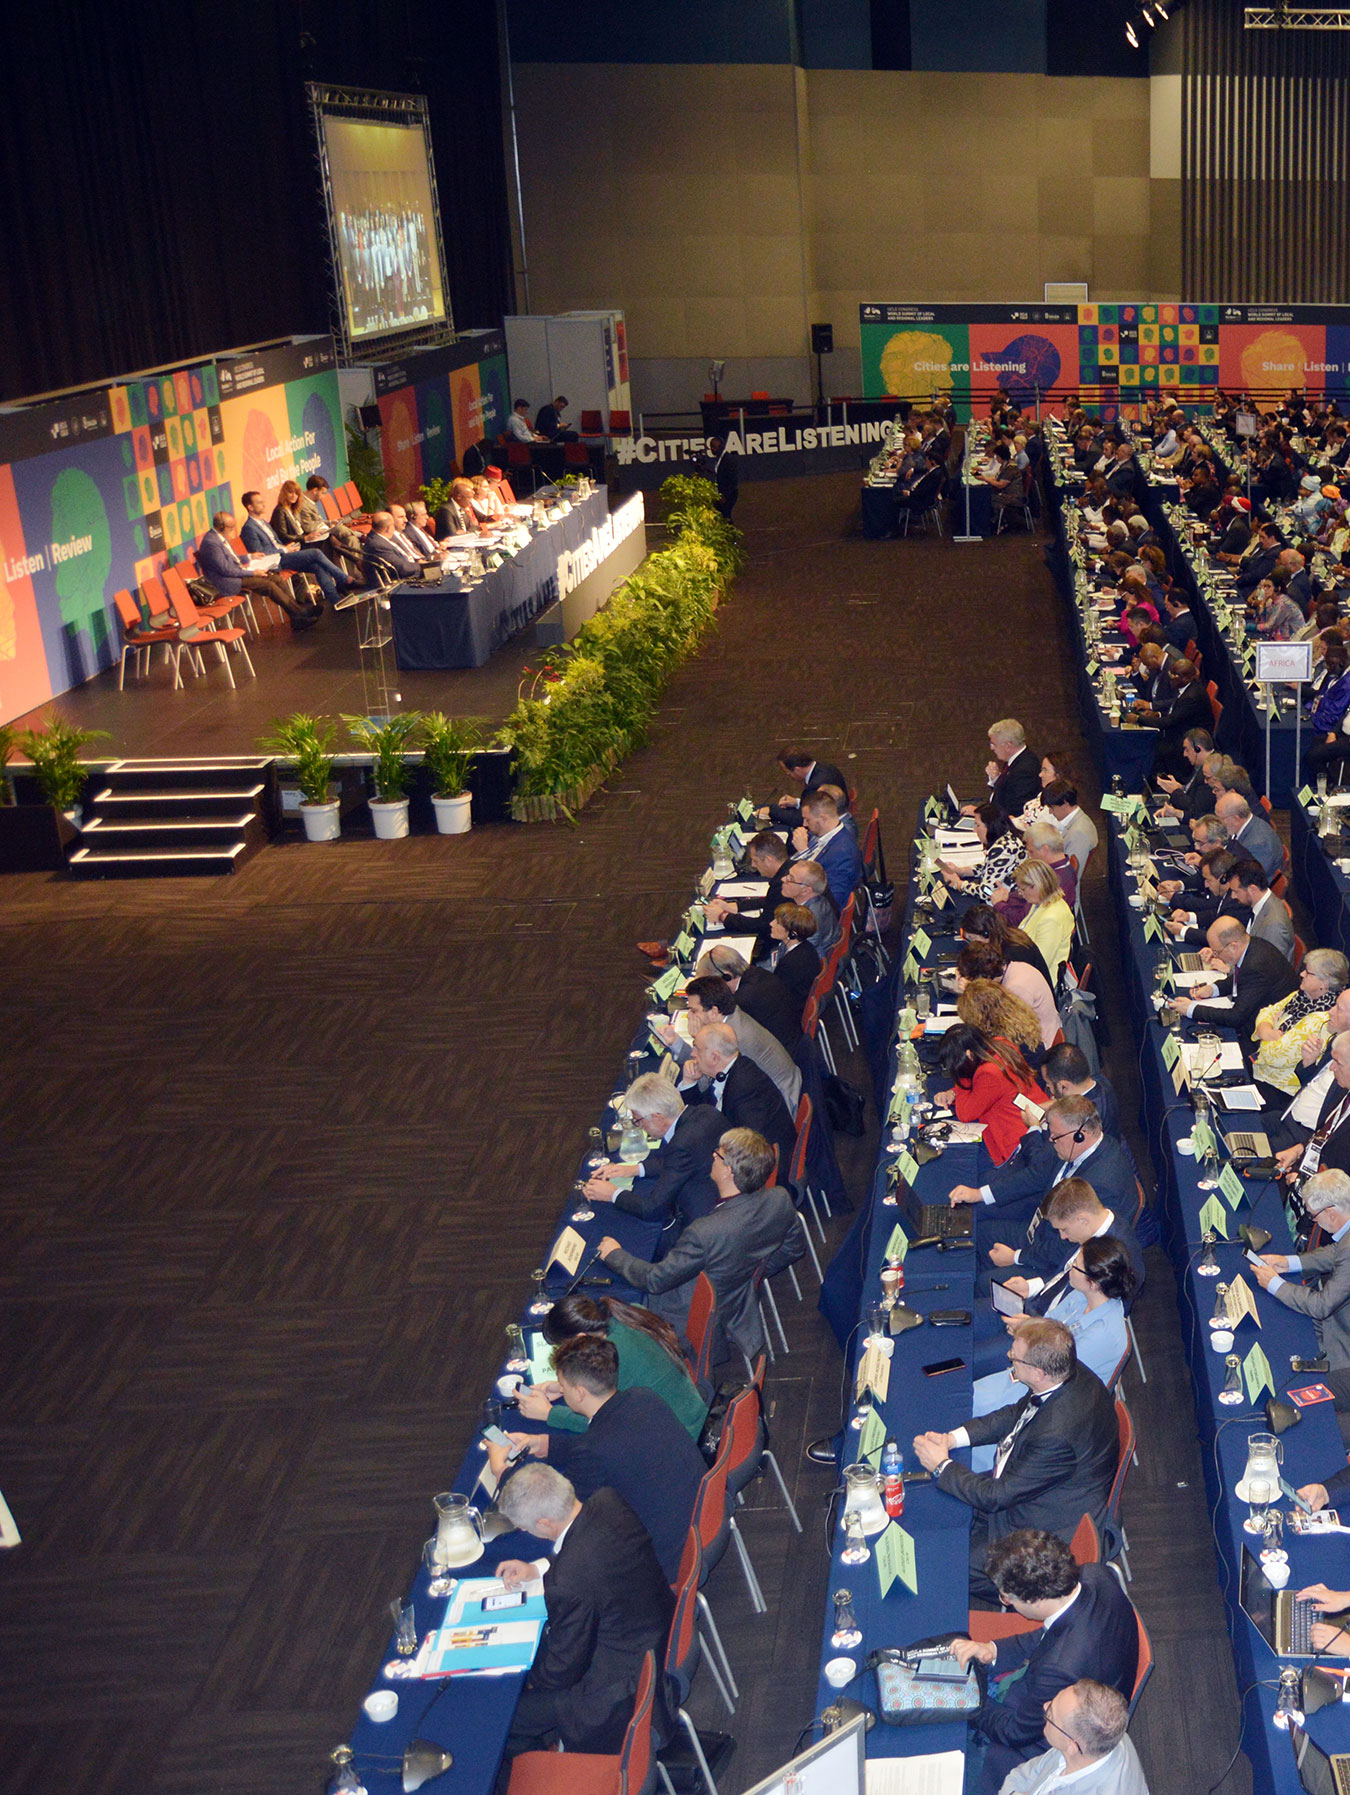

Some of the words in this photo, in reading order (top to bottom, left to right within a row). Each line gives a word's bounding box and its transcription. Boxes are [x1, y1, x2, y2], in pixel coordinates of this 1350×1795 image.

[914, 361, 947, 372] Cities
[950, 363, 970, 372] are
[973, 361, 1027, 374] Listening
[1262, 361, 1295, 372] Share
[1303, 361, 1339, 372] Listen
[265, 440, 285, 462] Local
[285, 434, 305, 452] Action
[304, 431, 316, 448] For
[266, 470, 280, 490] and
[299, 452, 321, 475] People
[3, 552, 45, 584] Listen
[51, 534, 92, 565] Review
